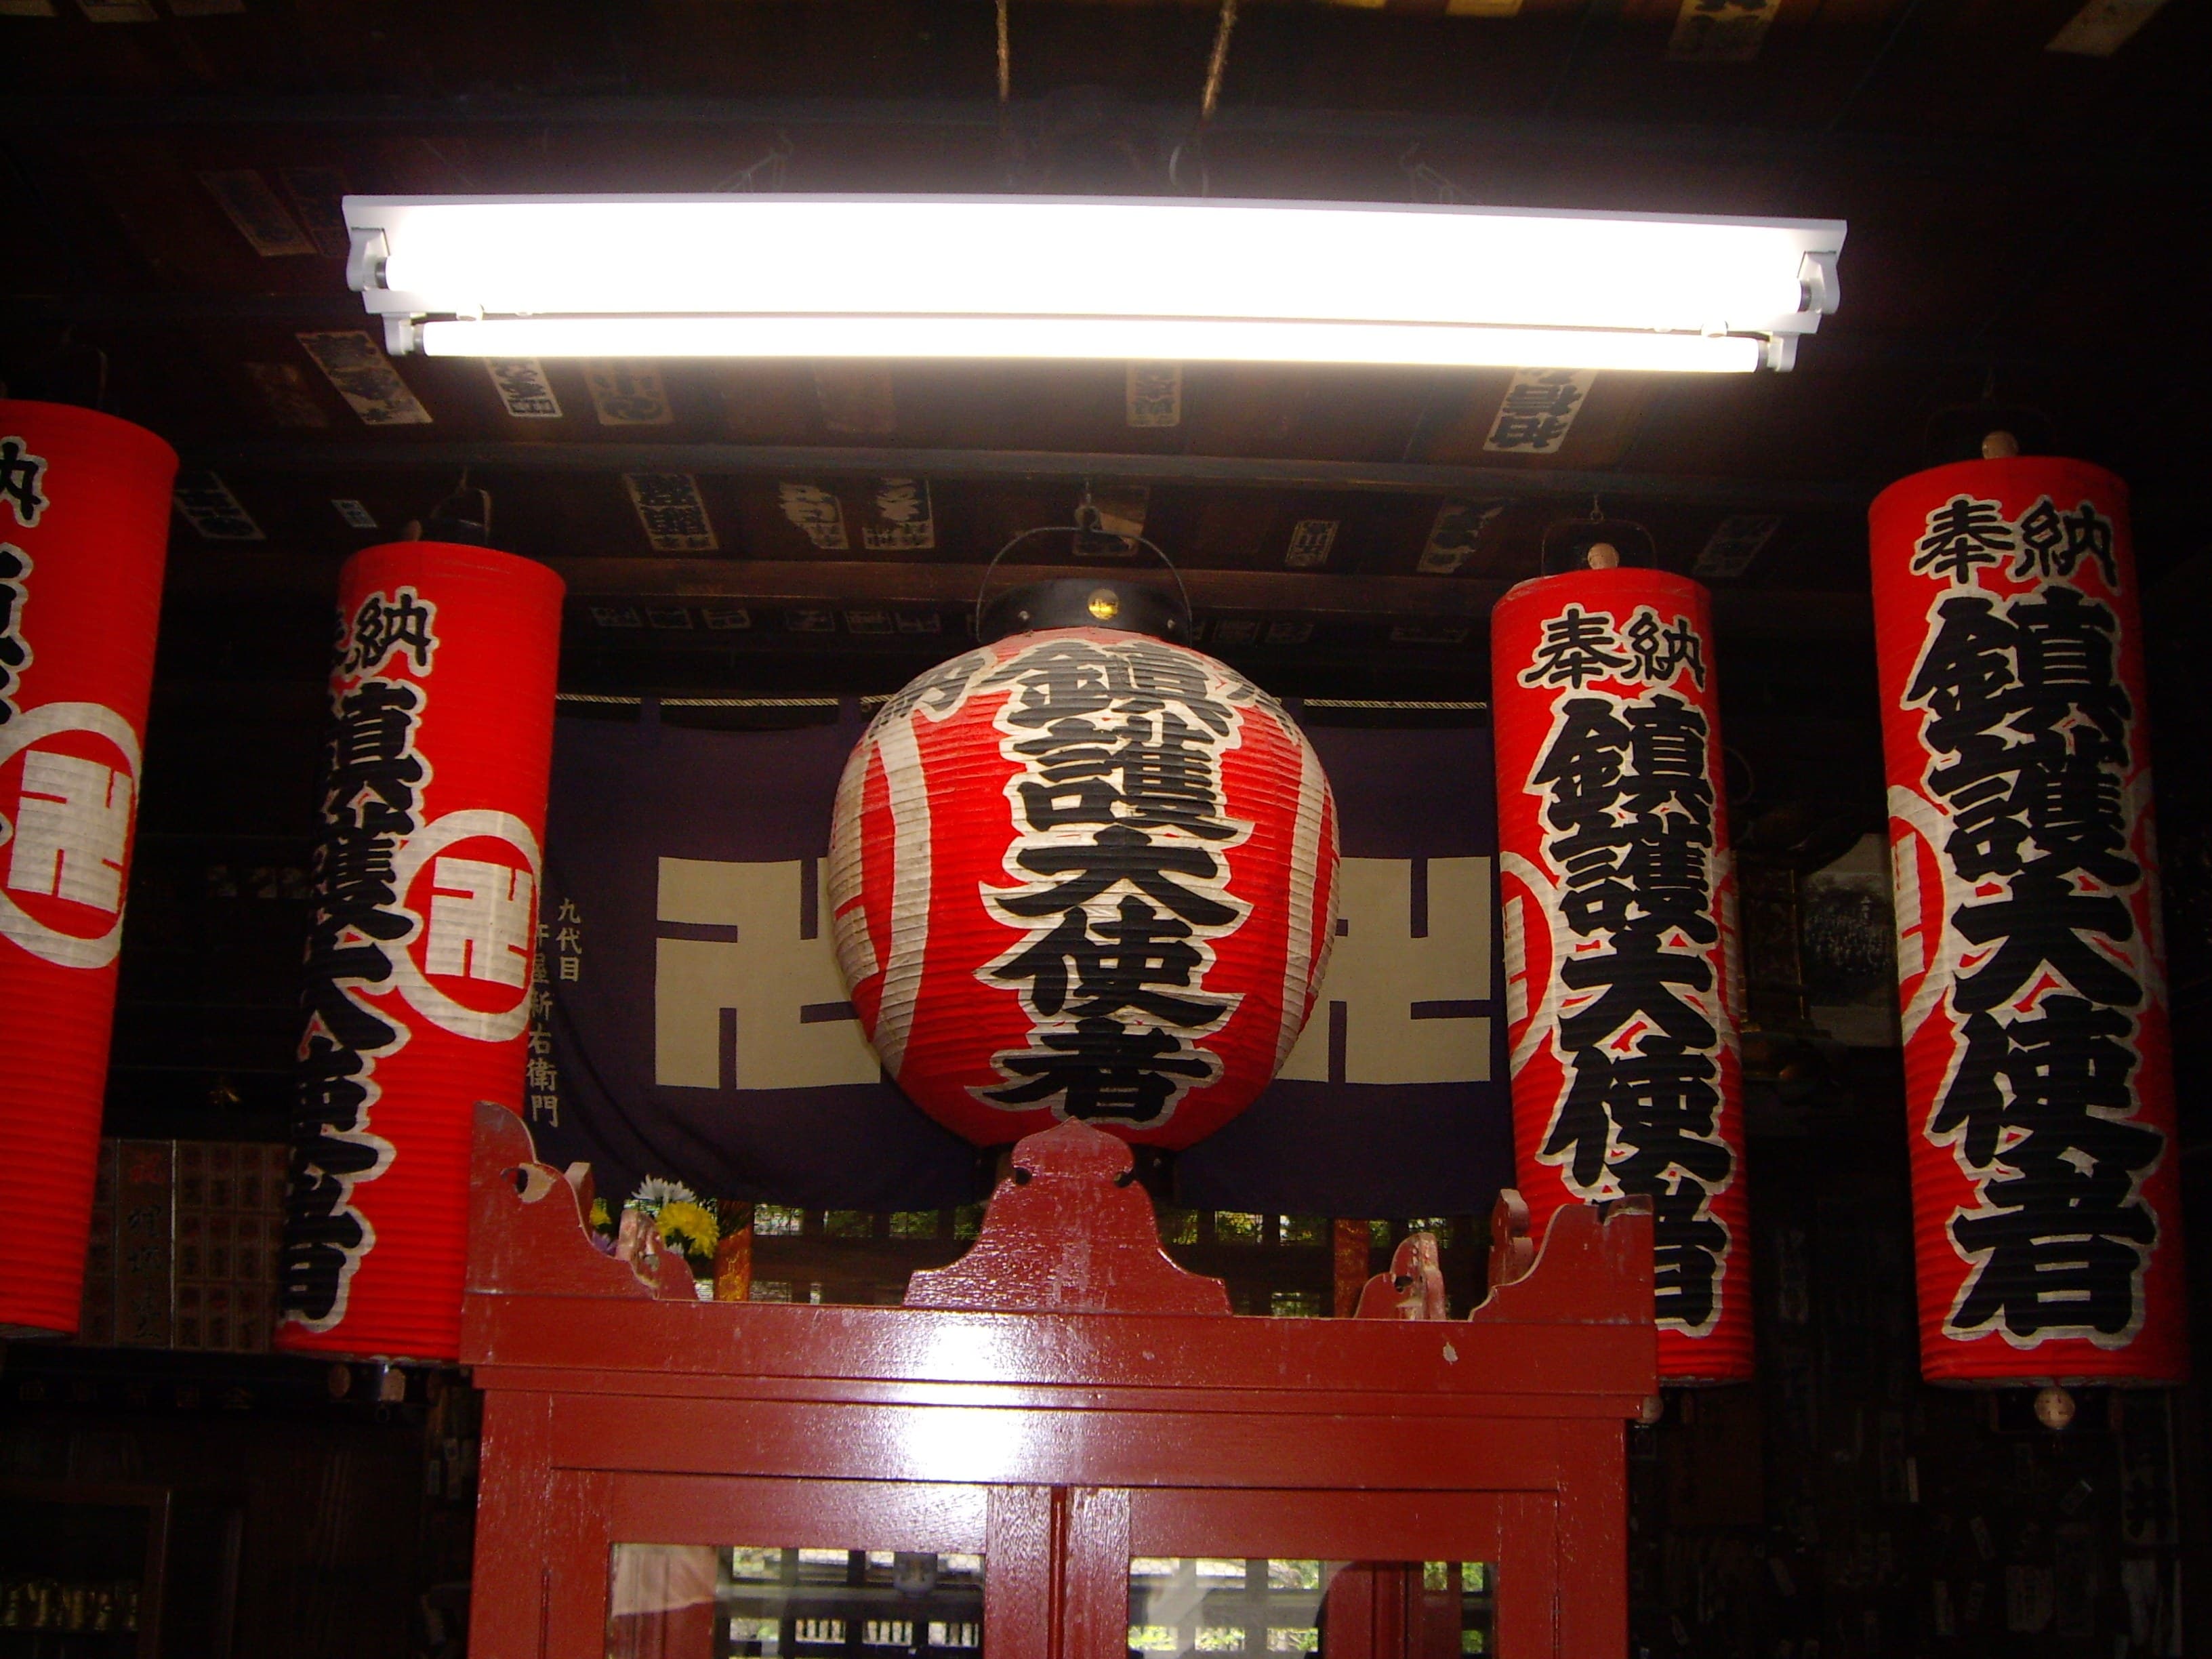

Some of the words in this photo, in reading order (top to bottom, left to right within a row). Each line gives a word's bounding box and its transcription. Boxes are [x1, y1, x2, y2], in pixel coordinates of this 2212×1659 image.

[1914, 500, 2117, 586] 奉納
[337, 593, 432, 672] 納
[1525, 608, 1706, 689] 奉納
[556, 897, 583, 983] 九代目
